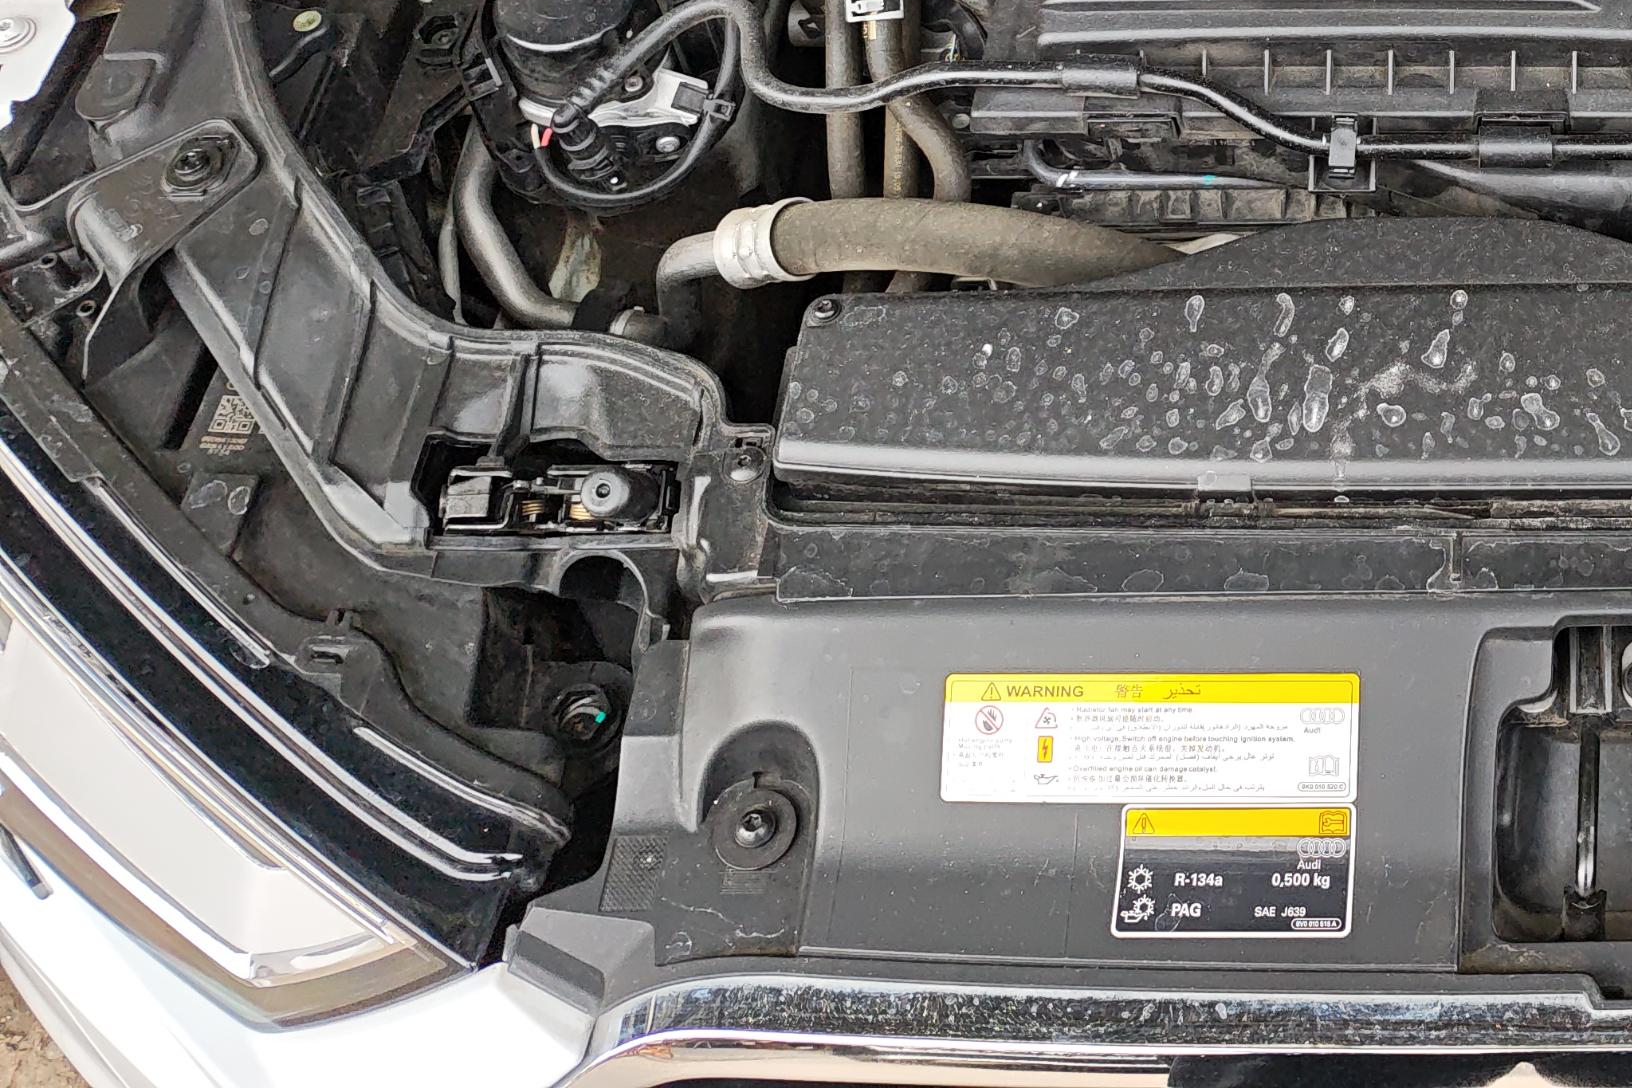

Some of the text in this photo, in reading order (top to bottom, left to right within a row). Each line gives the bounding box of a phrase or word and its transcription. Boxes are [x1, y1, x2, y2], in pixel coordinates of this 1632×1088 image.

[1006, 685, 1084, 698] WARNING
[1114, 683, 1143, 699] 警告
[1163, 683, 1201, 700] تحذير
[1159, 736, 1183, 744] engine
[1208, 735, 1238, 744] touching
[1297, 860, 1322, 871] Audi
[1174, 872, 1331, 890] R-134a 0,500 kg
[1170, 903, 1307, 918] PAG SAE J639
